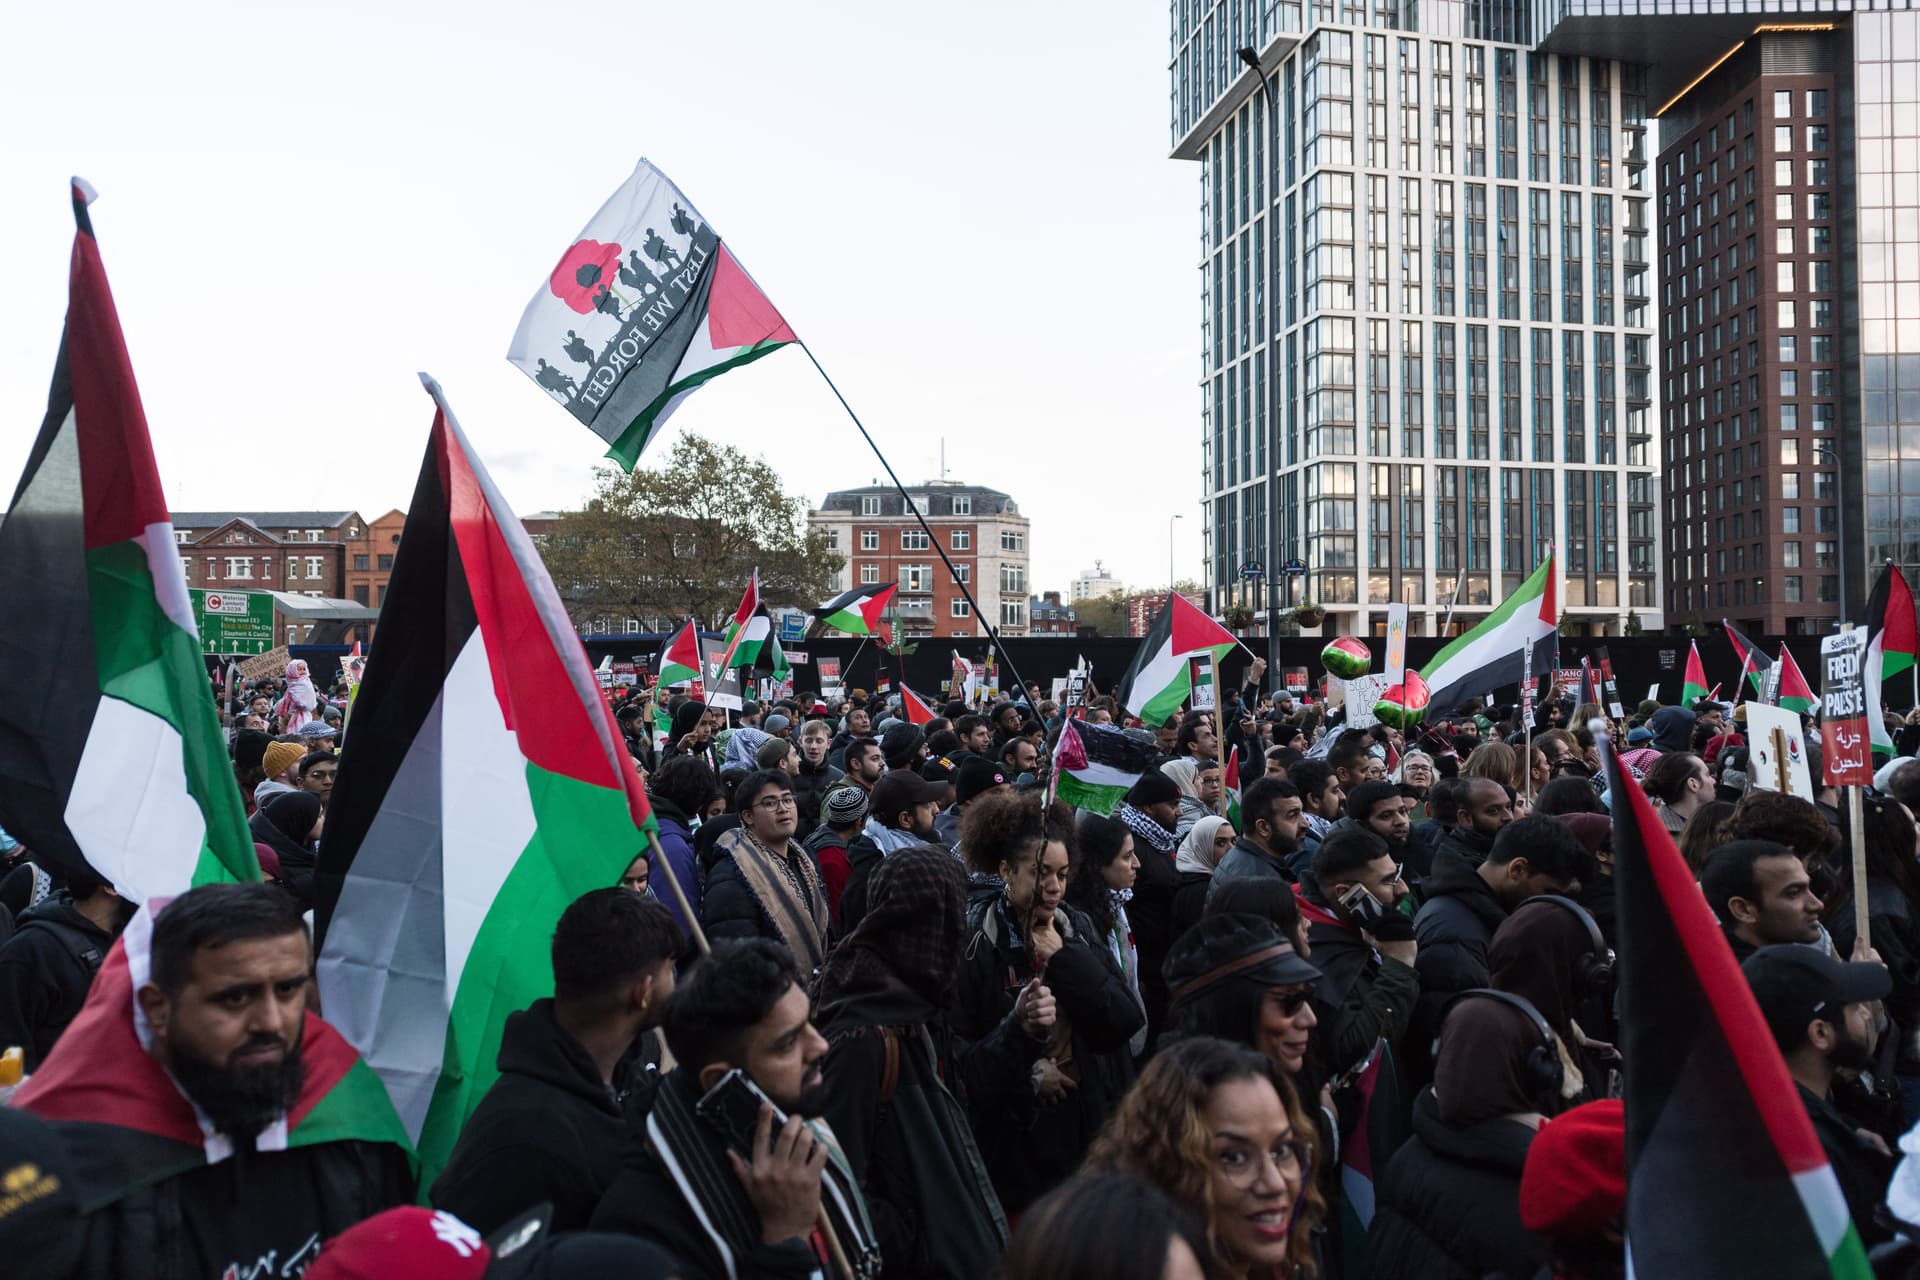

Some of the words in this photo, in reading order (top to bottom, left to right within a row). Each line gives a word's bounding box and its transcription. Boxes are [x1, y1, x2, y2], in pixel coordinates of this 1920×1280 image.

[710, 663, 736, 682] SIGE
[820, 663, 839, 675] FREE
[1285, 673, 1307, 685] FREE
